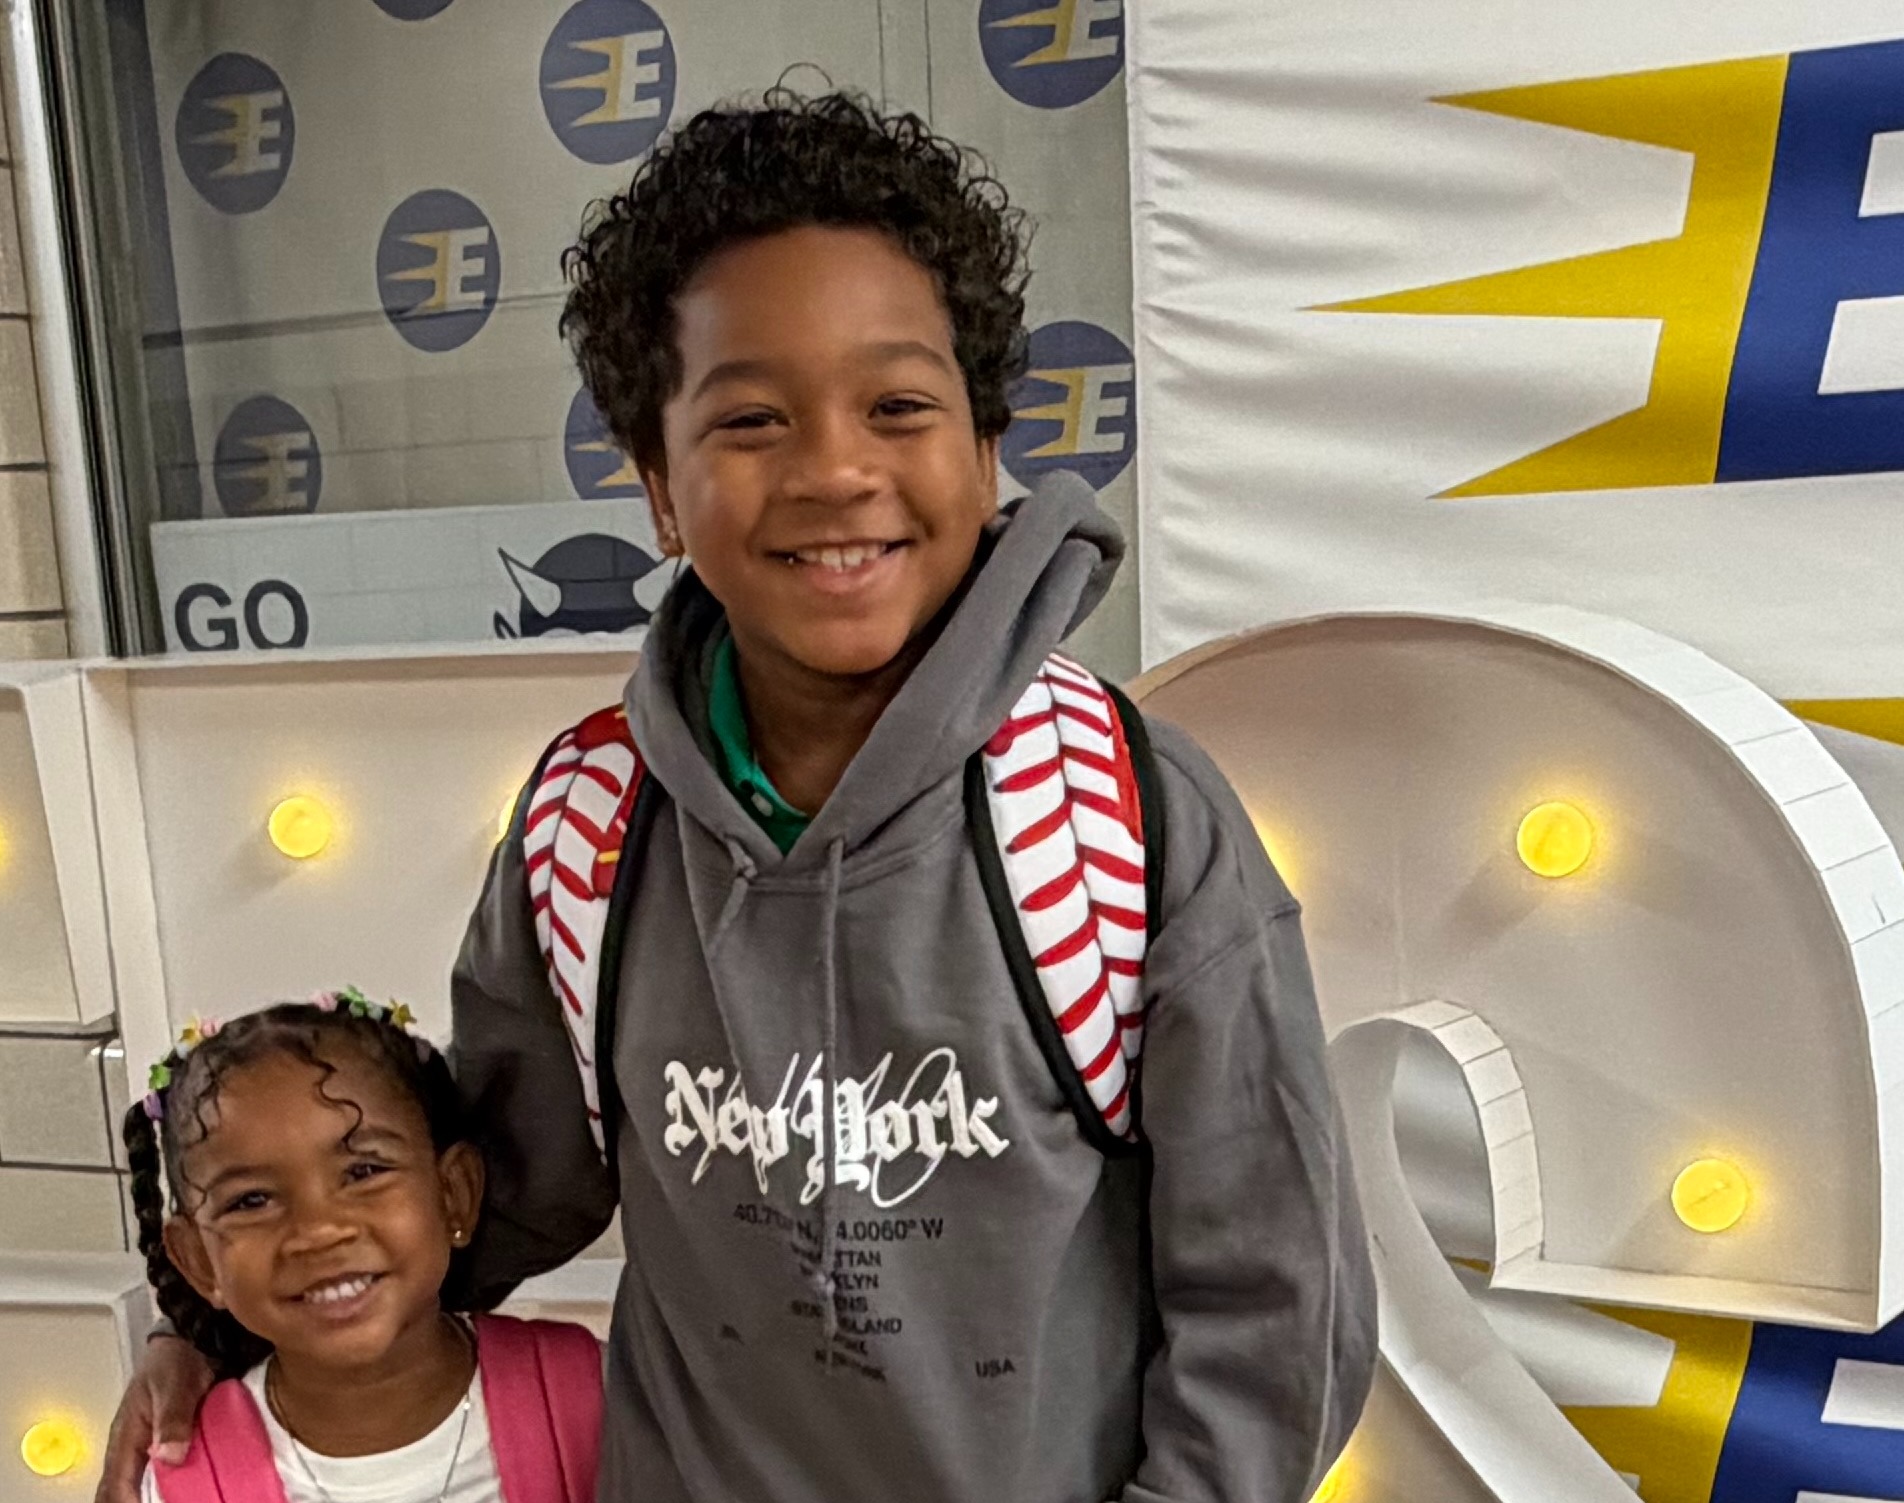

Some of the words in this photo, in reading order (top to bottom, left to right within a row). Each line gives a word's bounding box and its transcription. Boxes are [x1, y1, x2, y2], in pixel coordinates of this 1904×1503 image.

[175, 579, 310, 652] GO
[664, 1056, 793, 1172] New
[791, 1058, 1010, 1200] York
[835, 1219, 917, 1242] 4.0060°
[921, 1218, 944, 1240] W
[975, 1359, 1016, 1378] USA
